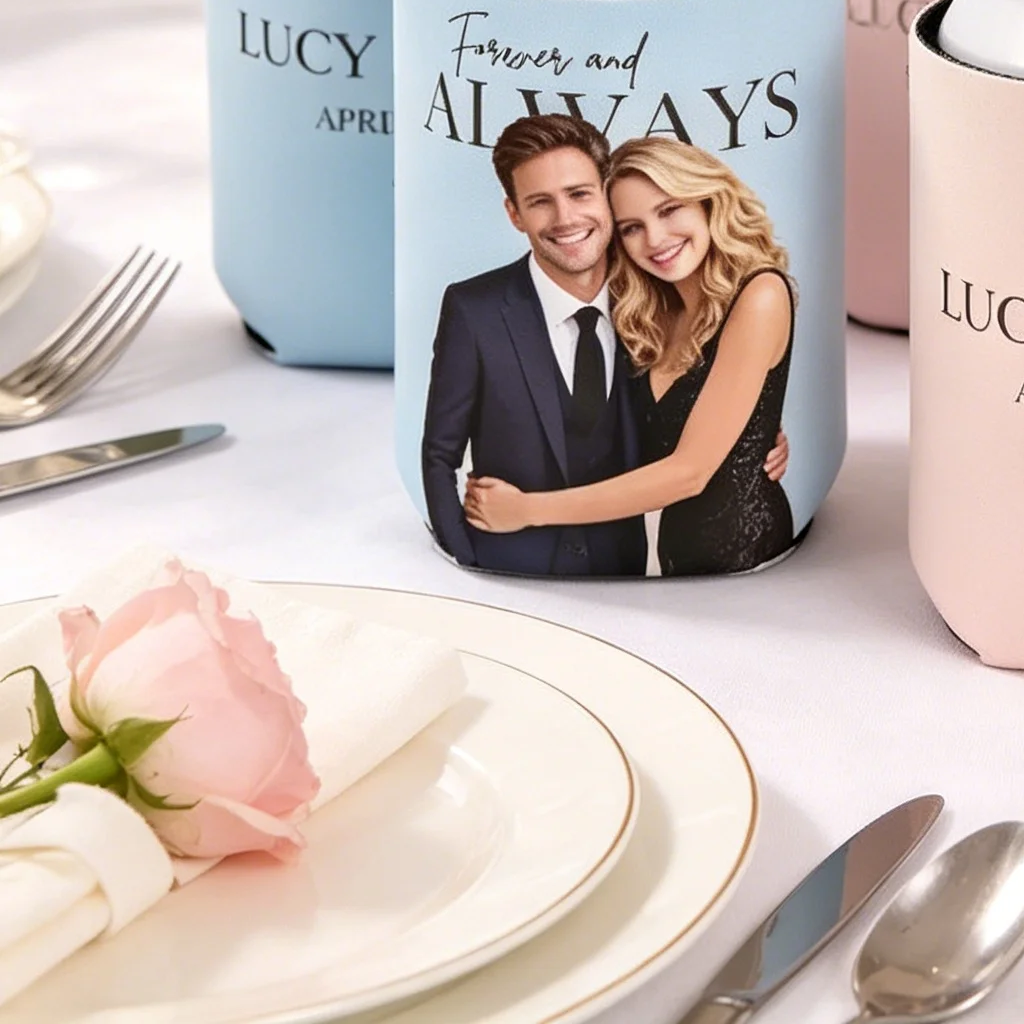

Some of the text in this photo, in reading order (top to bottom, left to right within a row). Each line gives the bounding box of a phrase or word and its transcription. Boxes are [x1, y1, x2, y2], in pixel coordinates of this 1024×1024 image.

[239, 9, 377, 79] LUCY
[585, 30, 650, 90] and
[315, 106, 394, 136] APRI
